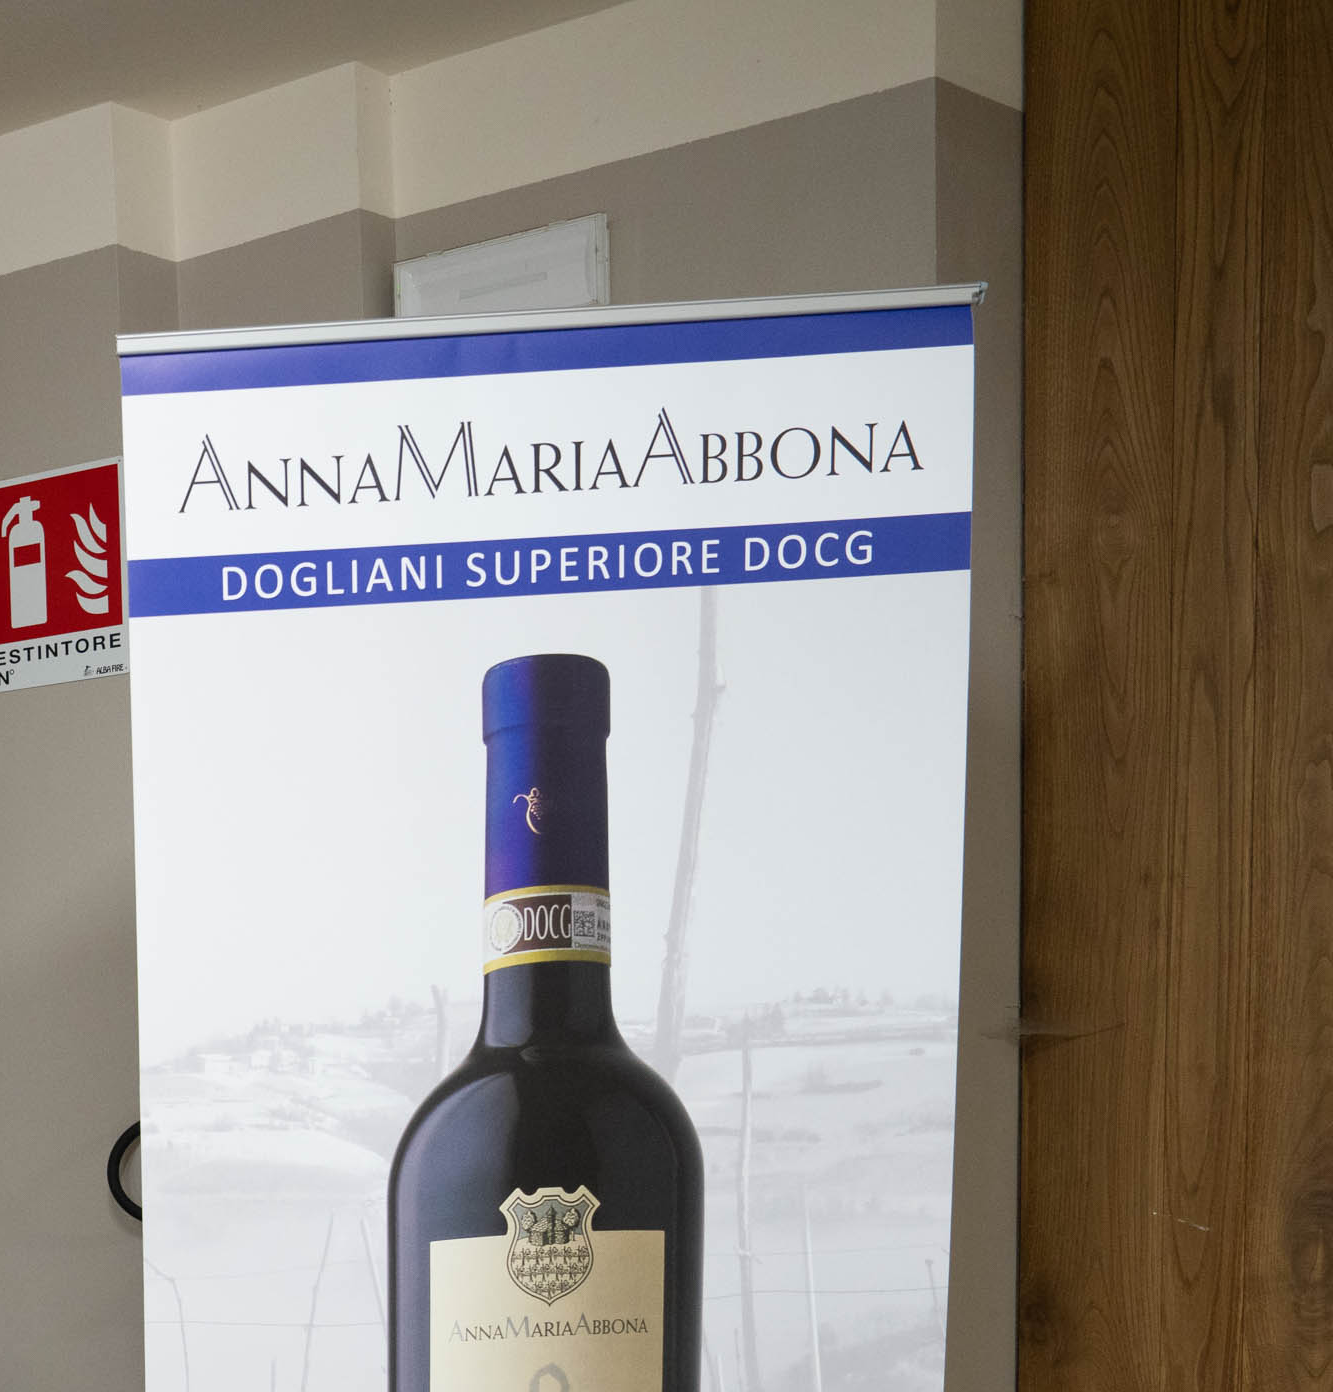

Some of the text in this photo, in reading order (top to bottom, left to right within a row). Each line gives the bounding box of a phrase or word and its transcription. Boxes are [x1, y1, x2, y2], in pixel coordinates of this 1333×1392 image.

[221, 530, 876, 601] DOGLIANI SUPERIORE DOCG
[524, 904, 571, 941] DOCG
